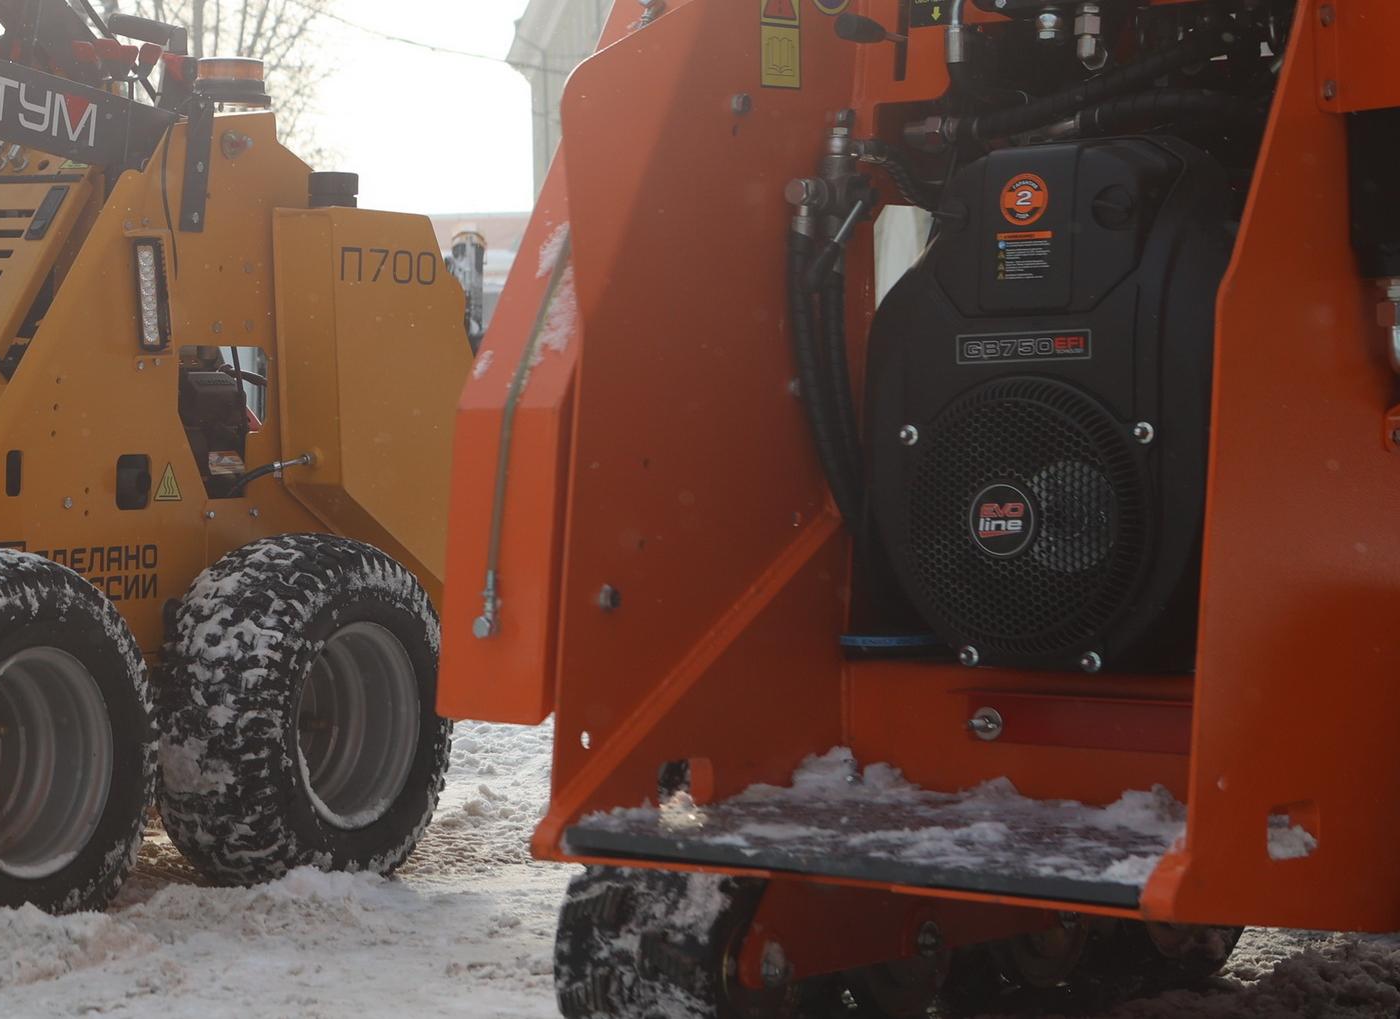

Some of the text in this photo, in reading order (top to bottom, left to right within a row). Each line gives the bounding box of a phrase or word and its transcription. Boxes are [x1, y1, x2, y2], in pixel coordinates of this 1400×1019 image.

[1015, 190, 1033, 206] 2
[341, 246, 437, 286] П700
[964, 337, 1055, 358] GB750
[979, 517, 1023, 531] line
[34, 543, 158, 576] ДЕЛАНО
